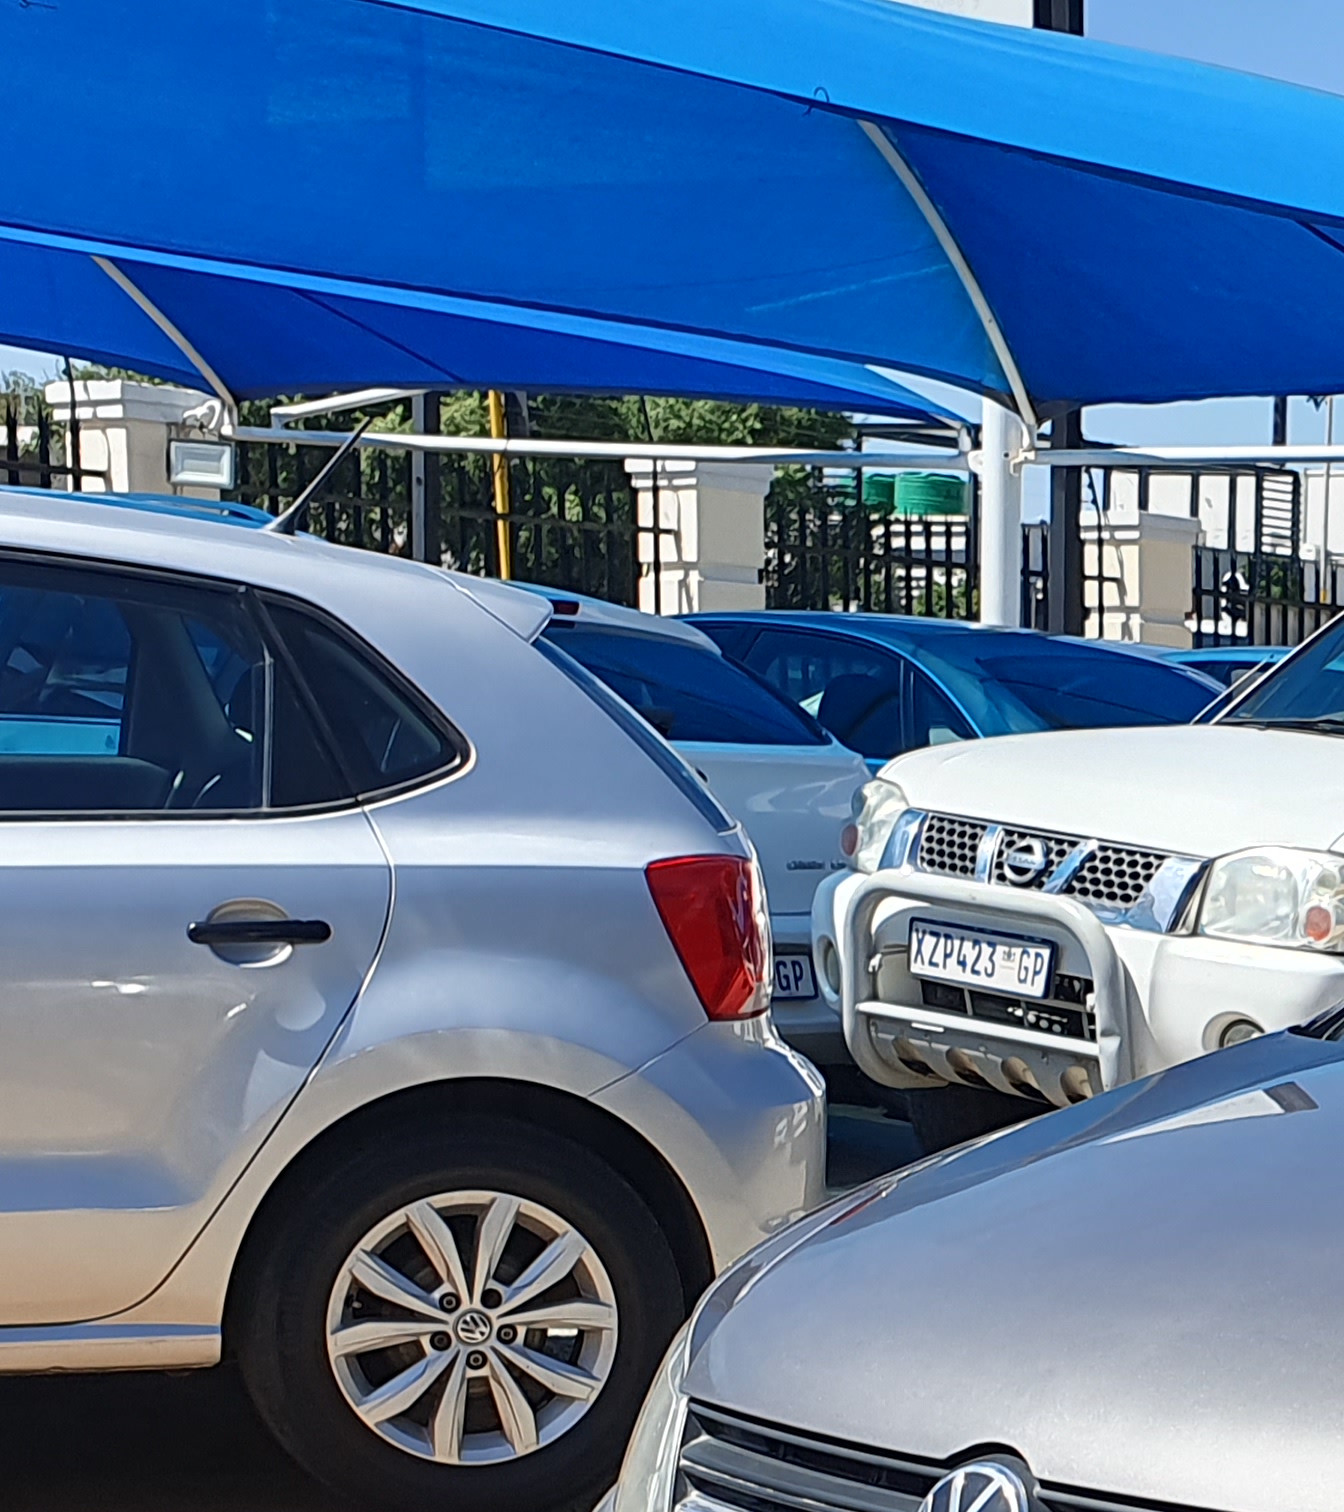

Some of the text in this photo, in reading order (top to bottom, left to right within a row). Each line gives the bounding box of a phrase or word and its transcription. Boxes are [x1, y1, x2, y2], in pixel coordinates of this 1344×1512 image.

[775, 960, 804, 991] GP
[913, 927, 1045, 987] XZP423 GP
